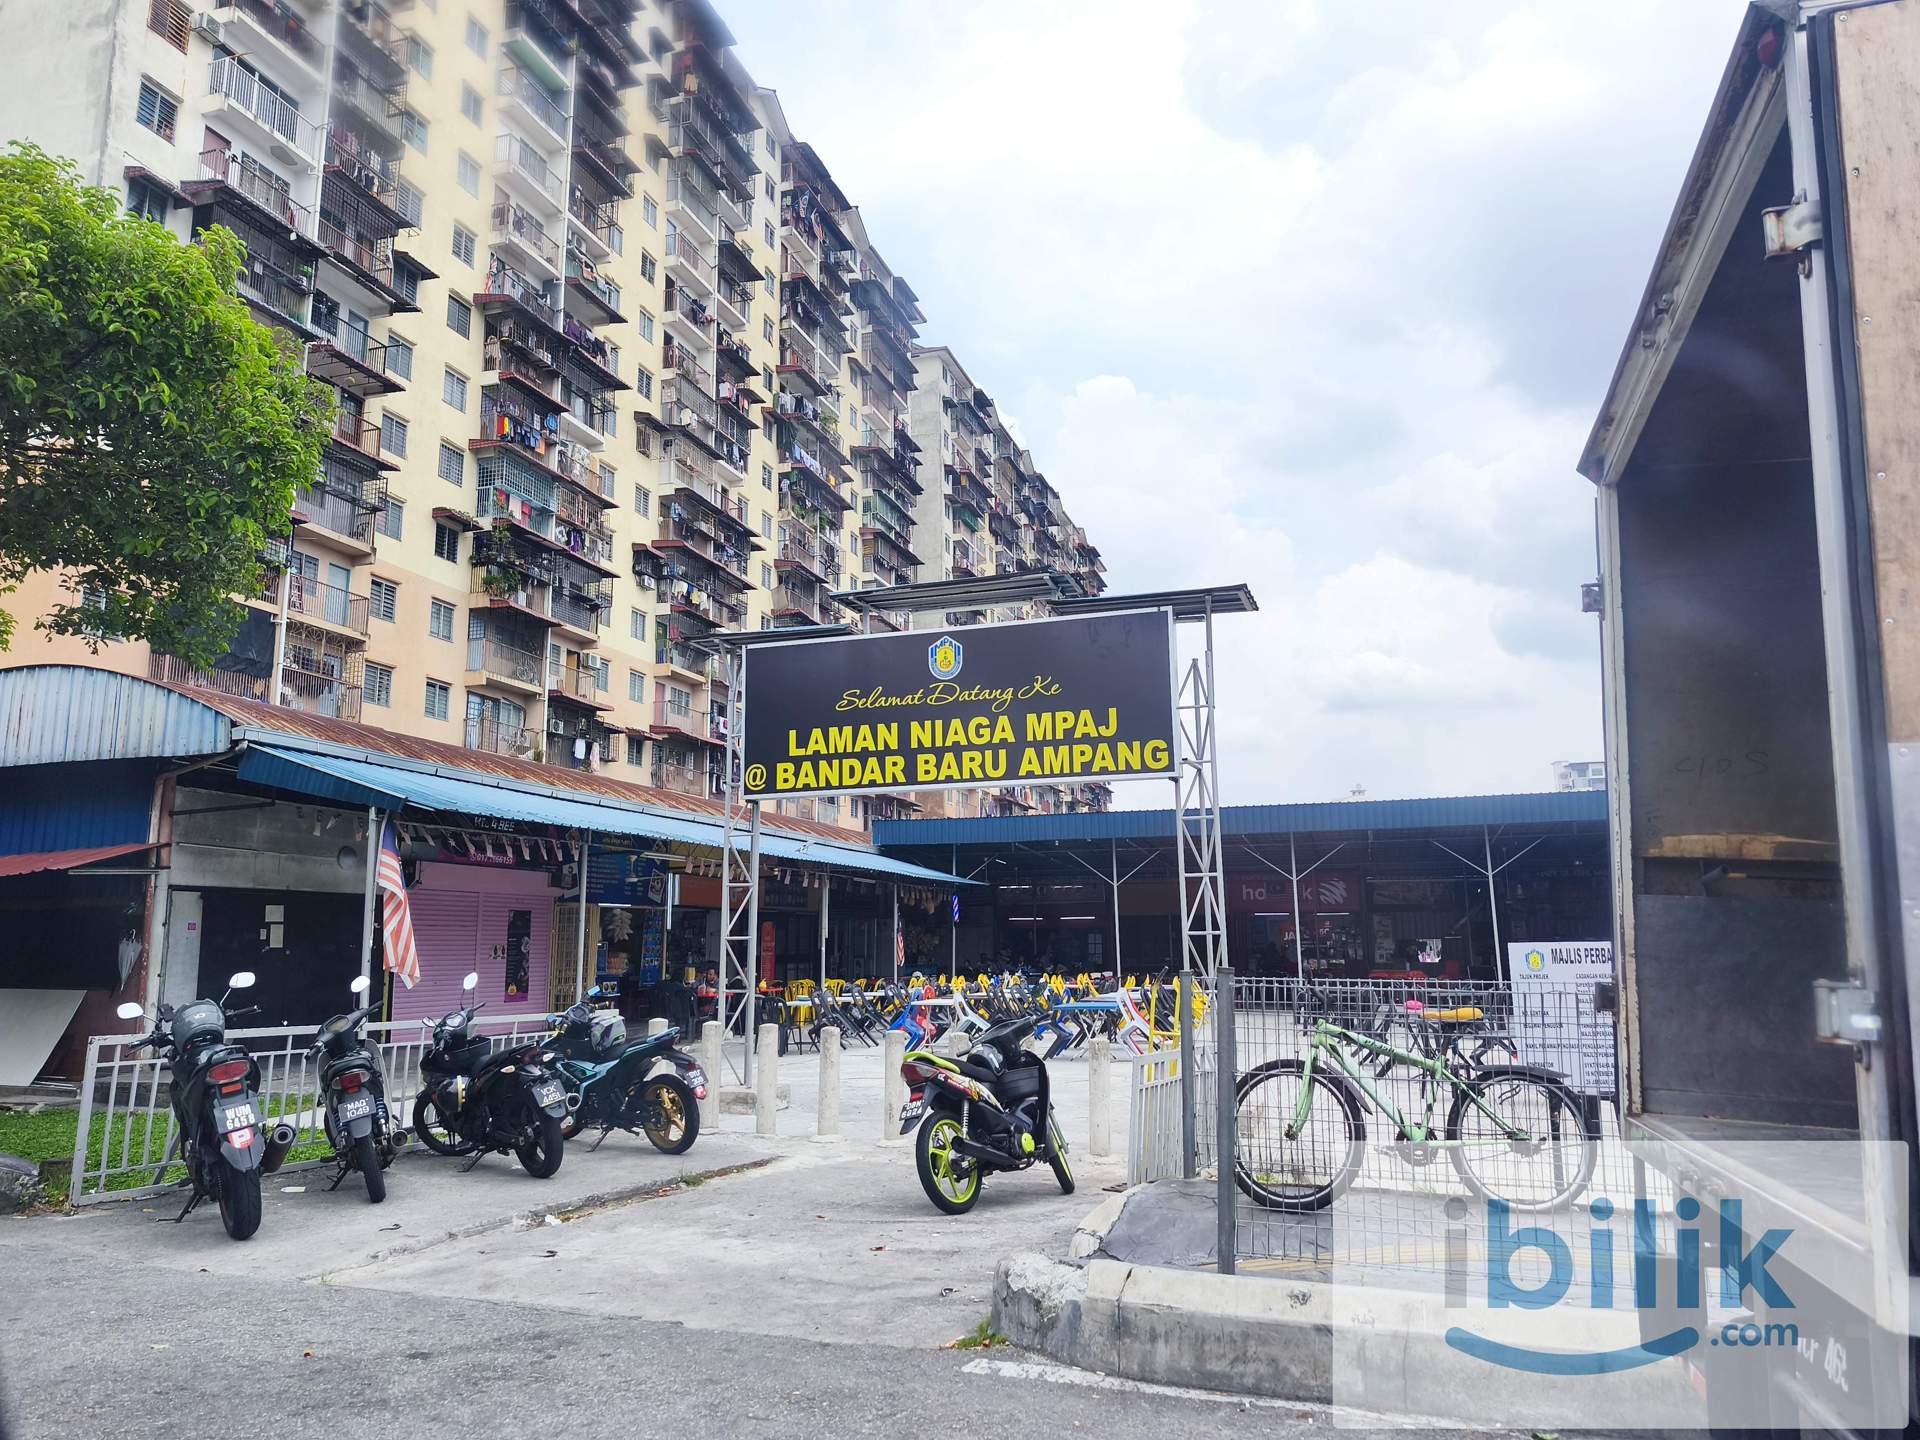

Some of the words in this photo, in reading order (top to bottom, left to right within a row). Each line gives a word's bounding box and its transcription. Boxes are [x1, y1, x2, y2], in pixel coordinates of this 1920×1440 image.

[835, 686, 925, 711] Selamat
[926, 682, 1013, 712] Datang
[1018, 675, 1062, 699] Ke
[788, 722, 898, 757] LAMAN
[910, 715, 1016, 749] NIAGA
[1026, 707, 1118, 742] MPAJ
[745, 763, 767, 791] @
[776, 755, 906, 790] BANDAR
[917, 749, 1007, 782] BARU
[1018, 739, 1169, 777] AMPANG
[1551, 948, 1582, 964] MAJLIS
[225, 1104, 251, 1119] WUM
[346, 1106, 369, 1118] 1049
[226, 1114, 256, 1130] 6458
